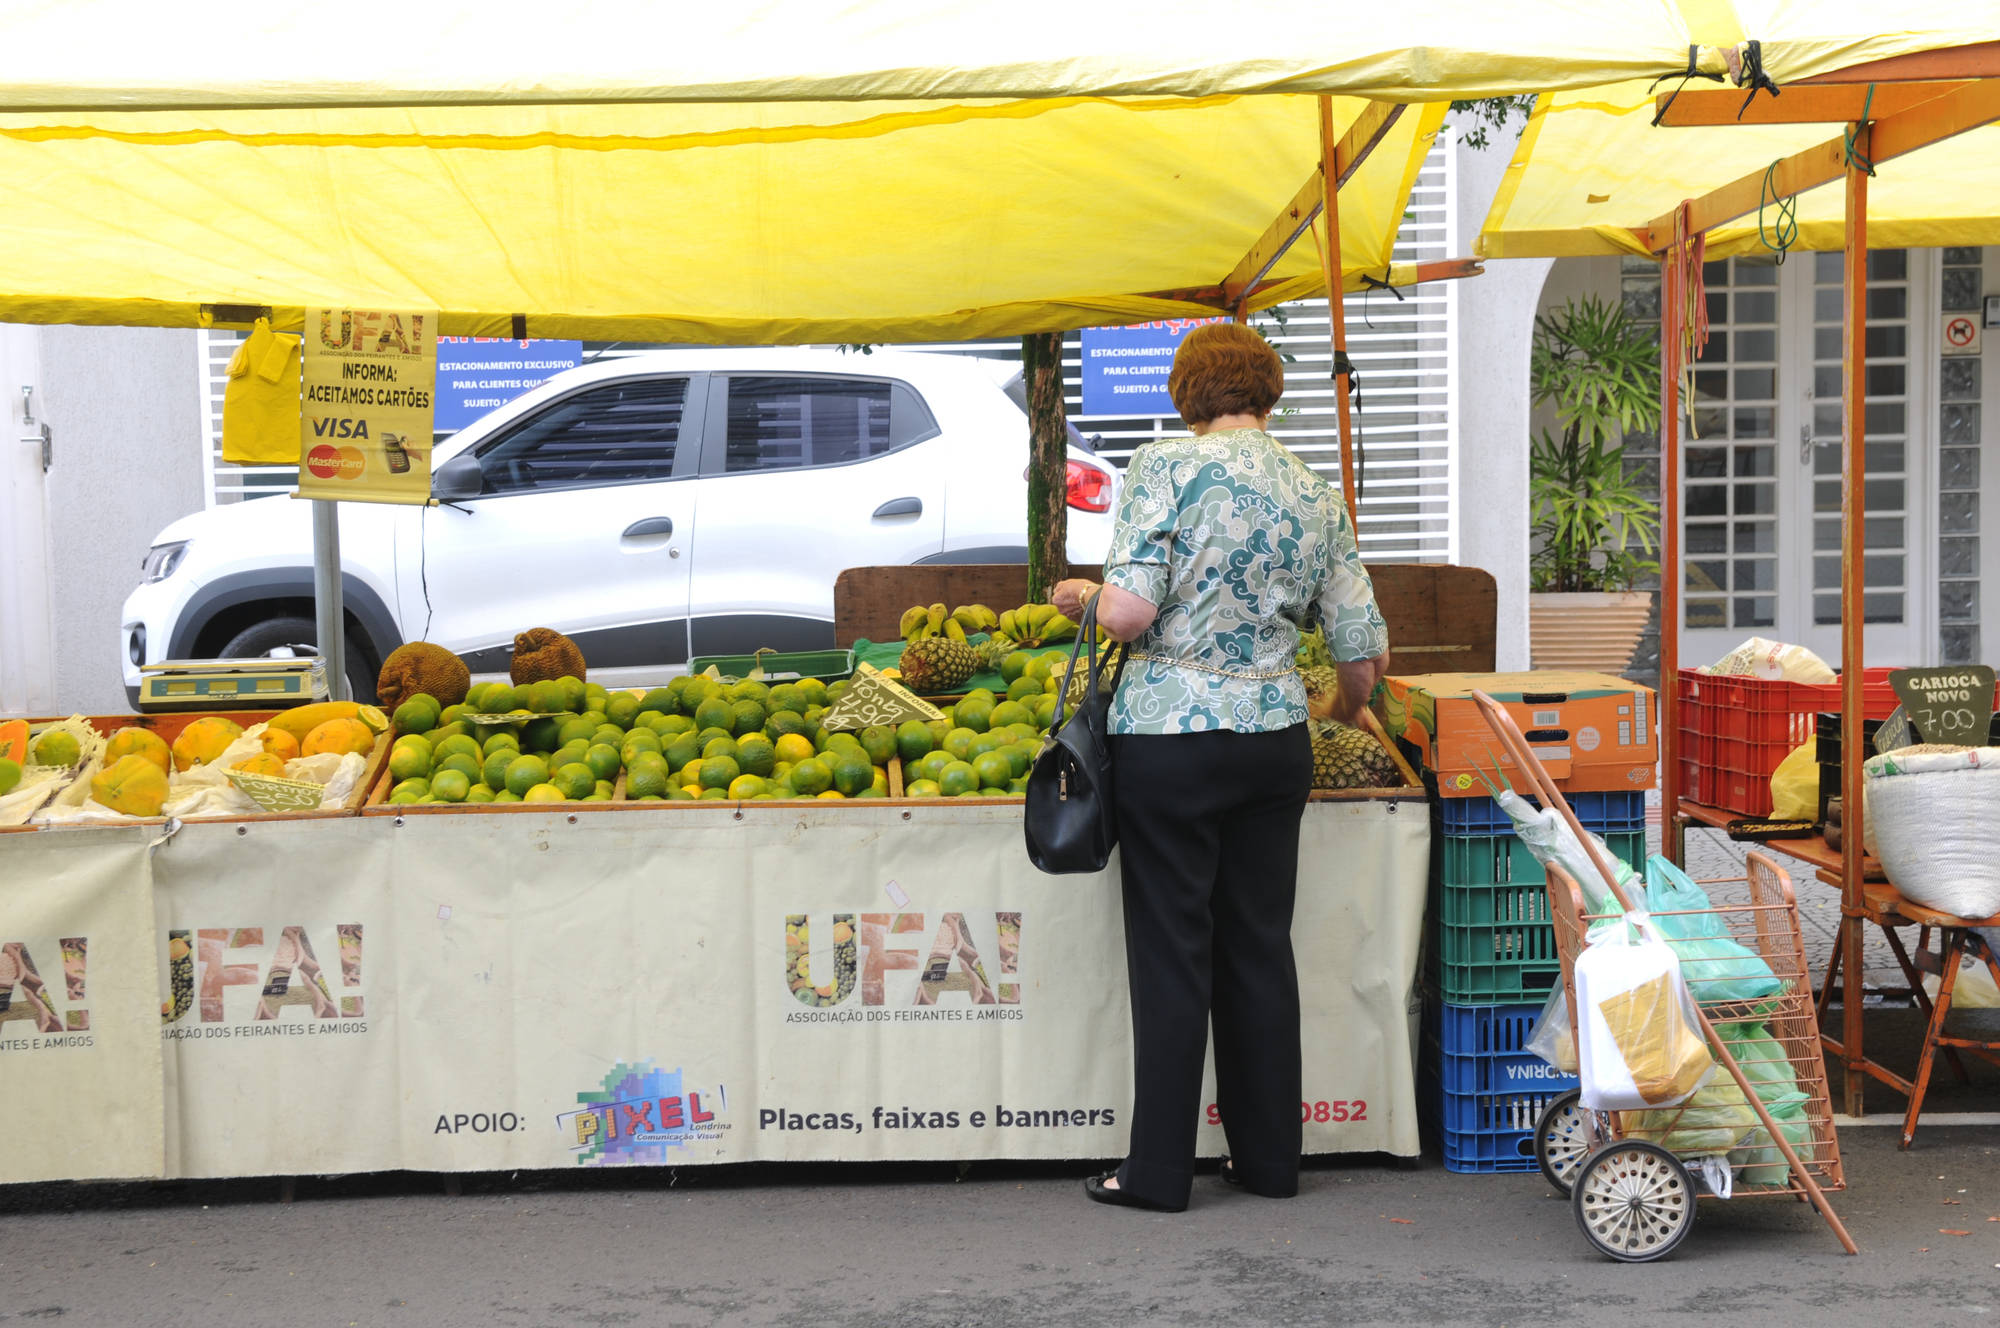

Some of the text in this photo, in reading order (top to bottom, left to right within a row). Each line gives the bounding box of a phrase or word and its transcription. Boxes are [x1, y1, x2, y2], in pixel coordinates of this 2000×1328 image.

[320, 310, 424, 355] UFA!
[1091, 348, 1173, 357] ESTACIONAMENTO
[342, 362, 397, 382] INFORMA:
[439, 360, 575, 371] ESTACIONAMENTO EXCLUSIVO
[1103, 366, 1171, 375] PARA CLIENTES
[453, 379, 549, 389] PARA CLIENTES QUA
[1113, 385, 1150, 394] SUJEITO
[1151, 385, 1158, 393] A
[308, 385, 429, 408] ACEITAMOS CARTÕES
[463, 398, 500, 408] SUJEITO
[312, 417, 369, 440] VISA
[308, 457, 364, 469] MasterCard
[1909, 675, 1981, 690] CARIOCA
[1926, 690, 1970, 703] NOVO
[785, 912, 1023, 1008] UFA!
[787, 1009, 1023, 1025] ASSOCIAÇÃO DOS FEIRANTES E AMIGOS
[206, 1027, 231, 1039] DOS
[235, 1024, 304, 1037] FEIRANTES
[308, 1024, 316, 1034] E
[320, 1022, 368, 1034] AMIGOS
[33, 1039, 40, 1049] E
[44, 1036, 94, 1048] AMIGOS
[434, 1112, 526, 1134] APOIO:
[575, 1092, 715, 1144] PIXEL
[760, 1105, 1115, 1134] Placas, faixas e banners
[690, 1122, 732, 1131] Londrina
[636, 1131, 724, 1142] Comunicação Visual
